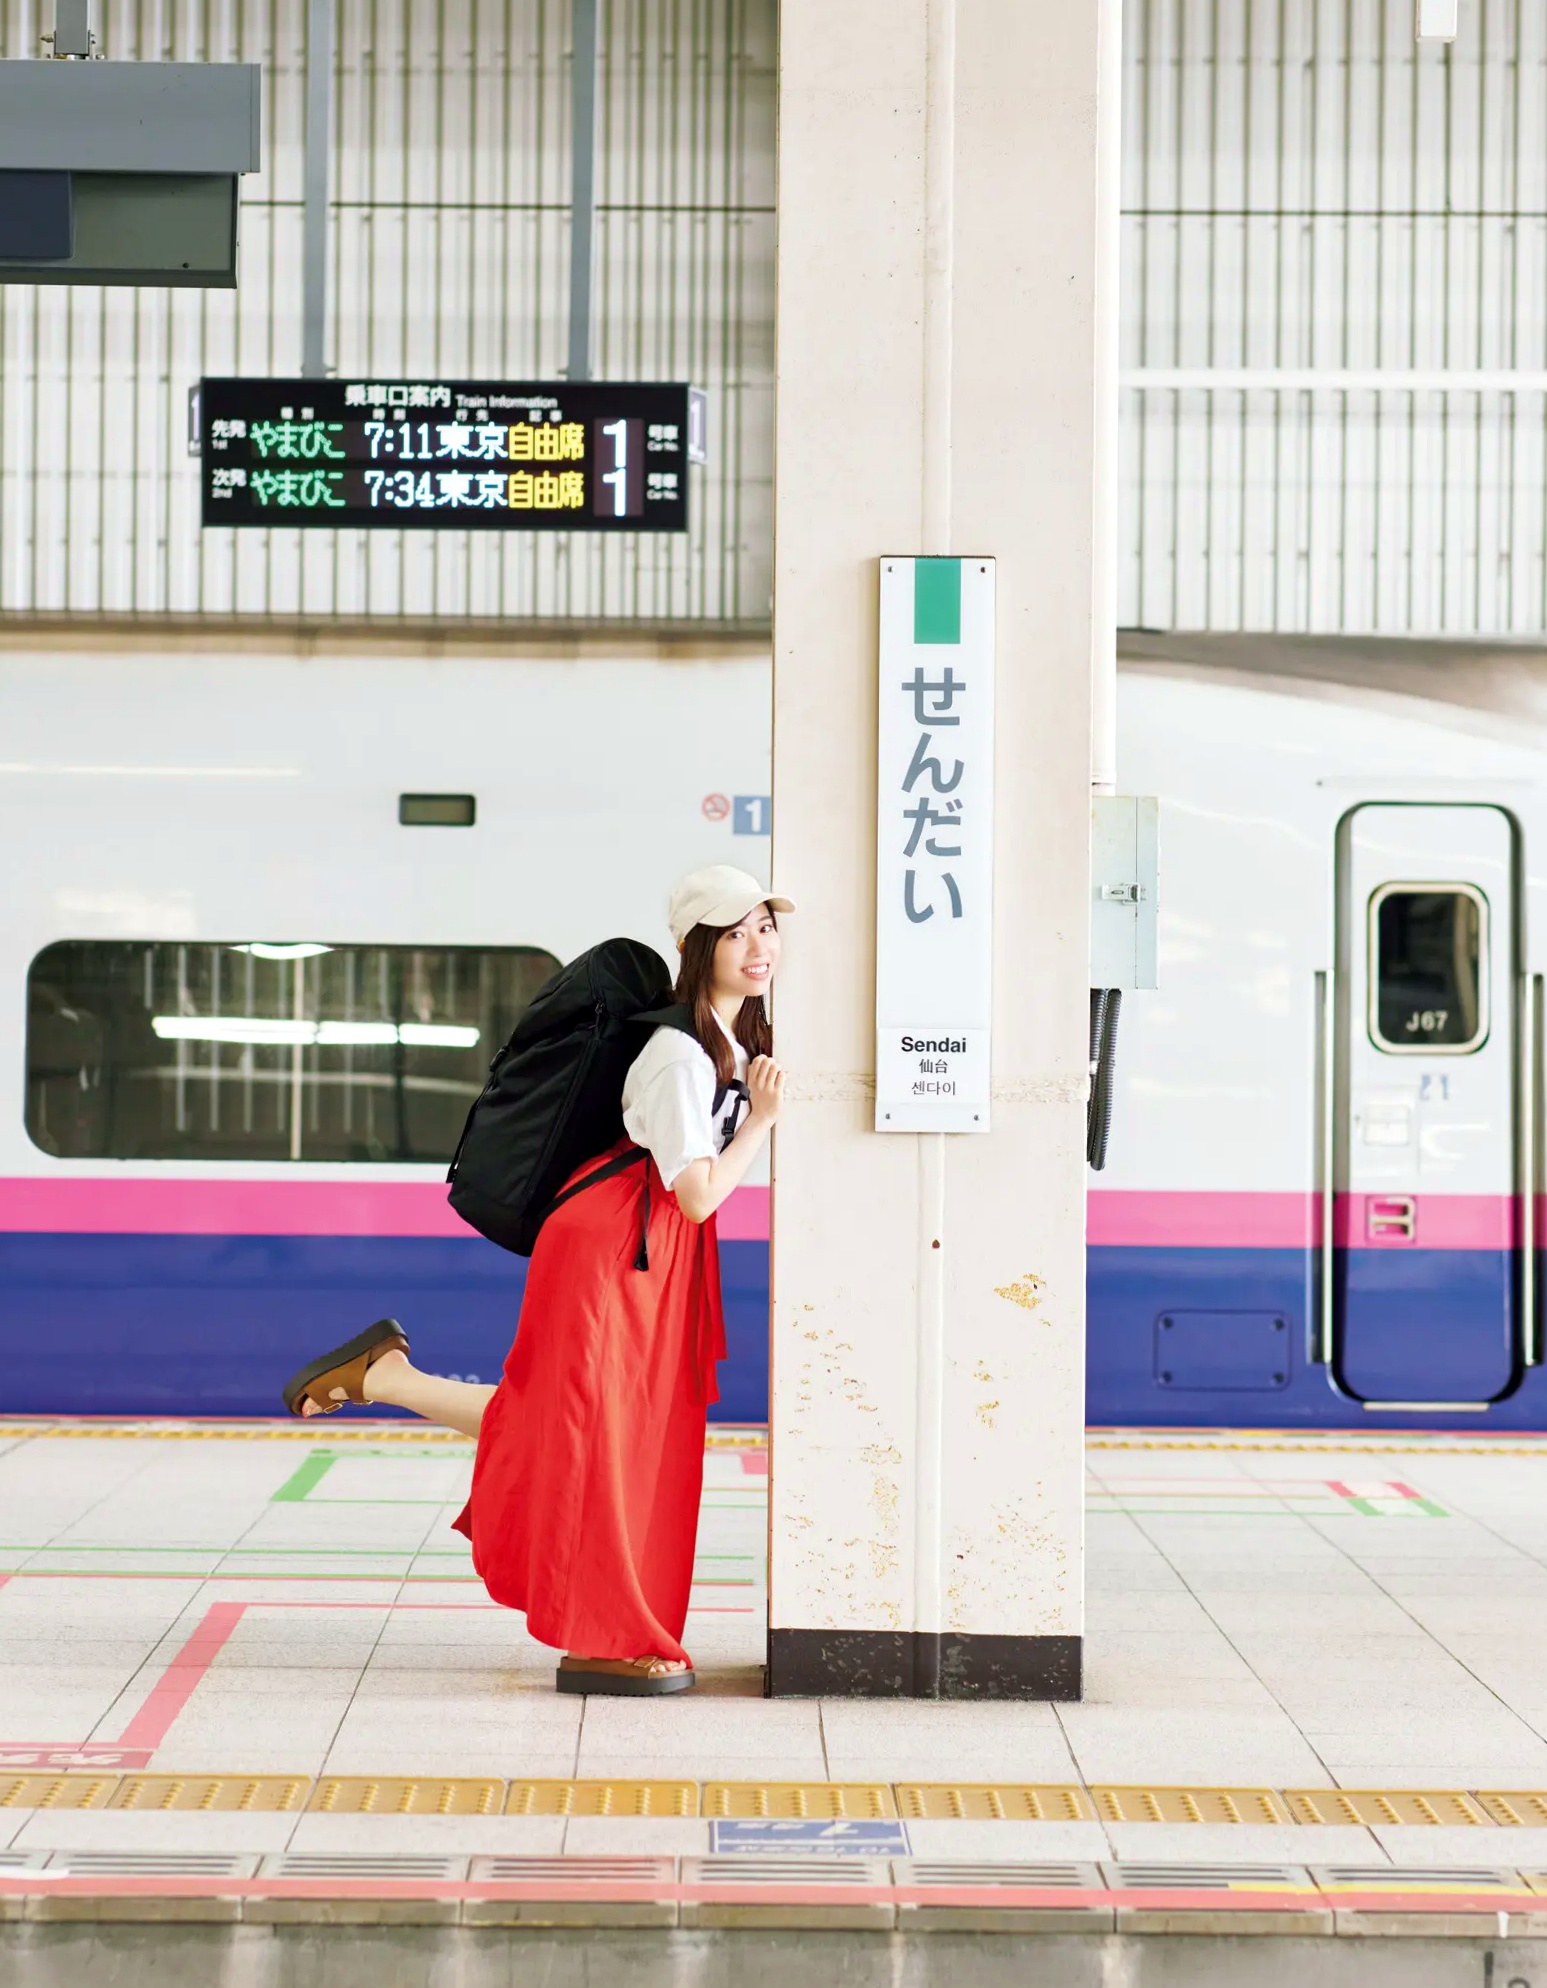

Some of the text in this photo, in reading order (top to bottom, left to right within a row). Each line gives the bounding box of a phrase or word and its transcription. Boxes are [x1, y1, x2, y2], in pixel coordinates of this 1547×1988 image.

[345, 385, 558, 409] 乗車口案内 Train Information
[211, 419, 247, 438] 先発
[250, 419, 627, 468] やまびこ 7:11 東京 自由席 1
[211, 468, 247, 487] 次発
[211, 488, 233, 499] 2nd
[250, 468, 627, 517] やまびこ 7:34 東京 自由席 1
[900, 667, 966, 924] せんだい
[744, 799, 762, 833] 1
[1405, 1010, 1449, 1032] J67
[901, 1036, 967, 1053] Sendai
[918, 1058, 949, 1074] 仙台
[911, 1080, 956, 1096] 센다이
